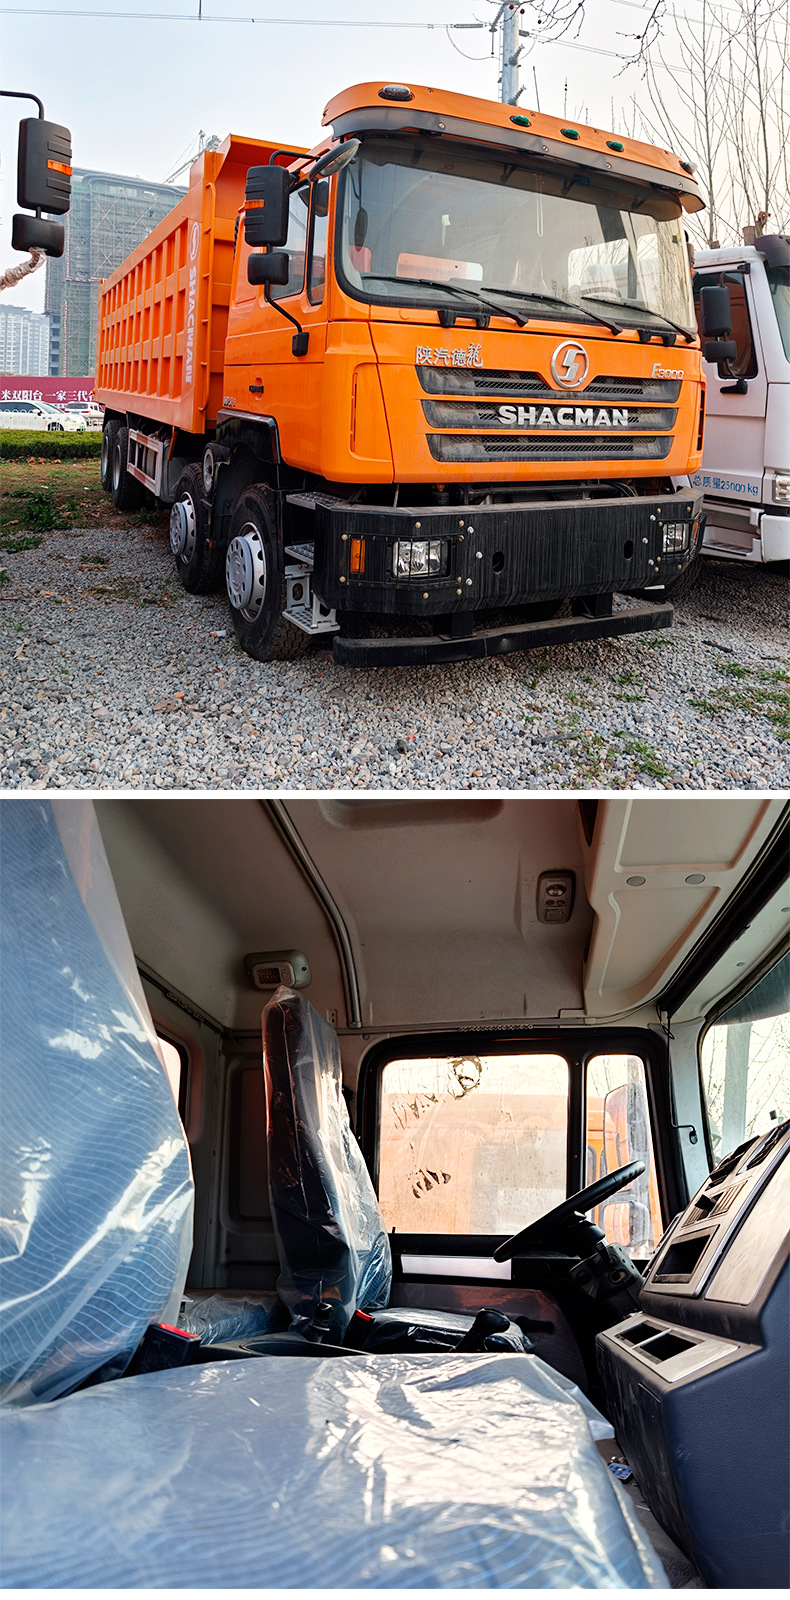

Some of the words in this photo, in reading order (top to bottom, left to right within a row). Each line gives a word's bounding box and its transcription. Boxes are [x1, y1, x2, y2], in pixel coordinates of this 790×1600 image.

[185, 266, 196, 383] SHACMAN
[650, 362, 684, 379] F3000
[1, 389, 43, 400] 米双阳台
[498, 405, 629, 426] SHACMAN
[747, 482, 759, 496] kg
